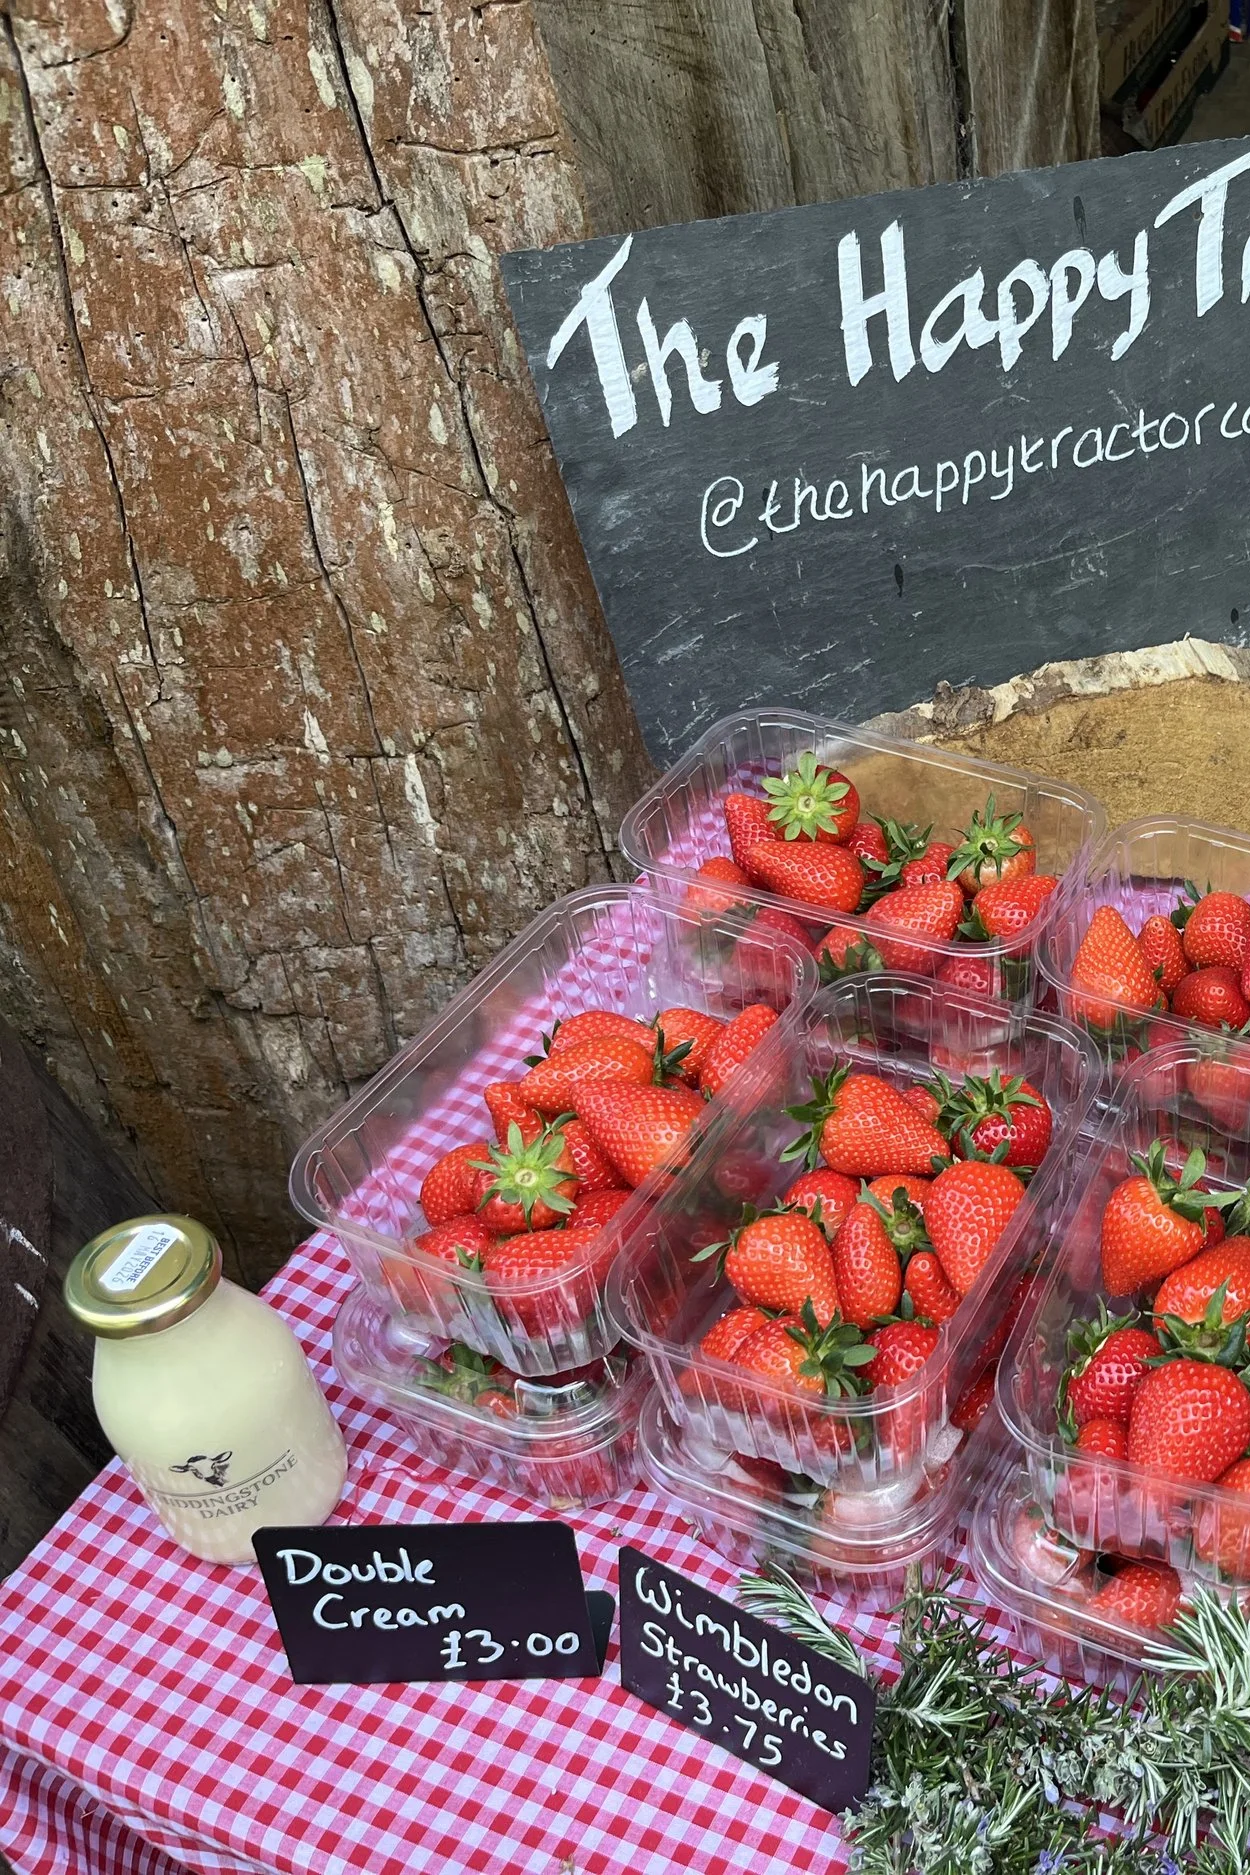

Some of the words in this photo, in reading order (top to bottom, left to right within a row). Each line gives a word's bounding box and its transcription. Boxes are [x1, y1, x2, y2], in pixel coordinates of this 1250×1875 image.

[546, 232, 780, 440] The
[836, 215, 1150, 374] Happy
[147, 1230, 165, 1242] 16
[152, 1238, 171, 1255] BEST
[126, 1256, 155, 1284] BEFORE
[200, 1495, 259, 1520] DAIRY
[276, 1548, 436, 1585] Double
[312, 1592, 466, 1630] Cream
[635, 1566, 858, 1726] Wimbledon
[640, 1621, 848, 1761] Strawberries
[665, 1671, 783, 1767] £3.75
